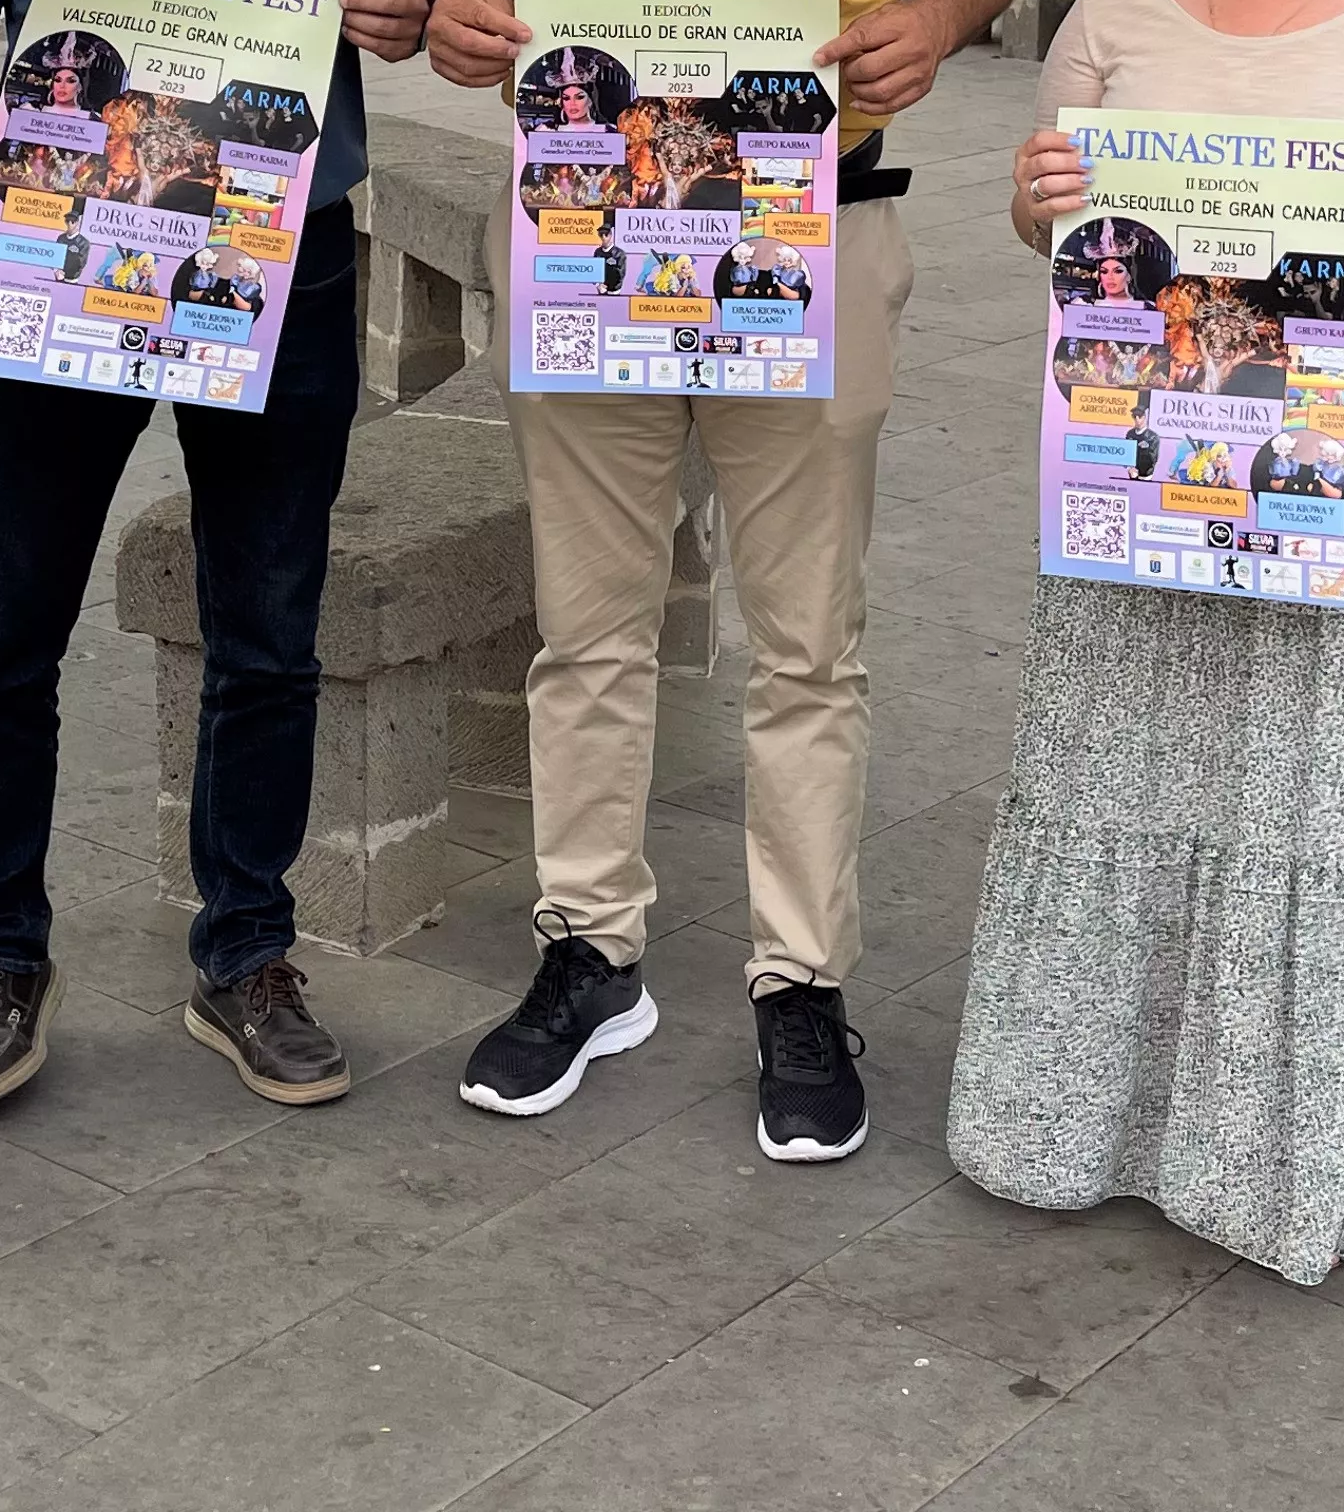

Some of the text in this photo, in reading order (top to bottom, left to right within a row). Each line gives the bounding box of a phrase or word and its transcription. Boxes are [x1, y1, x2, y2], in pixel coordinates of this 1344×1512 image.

[151, 0, 218, 22] II EDICIÓN
[642, 3, 711, 18] II EDICIÓN
[60, 5, 302, 62] VALSEQUILLO DE GRAN CANARIA
[551, 21, 803, 41] VALSEQUILLO DE GRAN CANARIA
[145, 57, 206, 82] 22 JULIO
[650, 62, 710, 77] 22 JULIO
[158, 79, 185, 94] 2023
[667, 82, 693, 93] 2023
[732, 75, 818, 95] KARMA
[223, 83, 307, 116] KARMA
[30, 118, 54, 129] DRAG
[549, 139, 573, 147] DRAG
[748, 140, 810, 149] GRUPO KARMA
[1075, 124, 1276, 170] TAJINASTE
[228, 149, 288, 167] GRUPO KARMA
[1185, 175, 1259, 194] II EDICIÓN
[14, 194, 63, 211] COMPARSA
[1090, 190, 1194, 216] VALSEQUILLO
[1202, 200, 1221, 215] DE
[1229, 200, 1274, 219] GRAN
[95, 206, 144, 229] DRAG
[547, 216, 594, 226] COMPARSA
[628, 215, 674, 232] DRAG
[89, 223, 198, 250] GANADOR LAS PALMAS
[623, 234, 732, 245] GANADOR LAS PALMAS
[5, 242, 54, 258] STRUENDO
[1192, 239, 1256, 258] 22 JULIO
[546, 264, 593, 272] STRUENDO
[1210, 260, 1237, 273] 2023
[92, 296, 117, 307] DRAG
[117, 300, 129, 309] LA
[639, 304, 662, 312] DRAG
[664, 304, 675, 312] LA
[731, 306, 755, 314] DRAG
[183, 310, 207, 320] DRAG
[1085, 313, 1110, 323] DRAG
[1295, 326, 1326, 336] GRUPO
[1079, 393, 1128, 406] COMPARSA
[1162, 398, 1212, 417] DRAG
[1157, 417, 1273, 436] GANADOR LAS PALMAS
[1076, 443, 1125, 455] STRUENDO
[1170, 492, 1195, 502] DRAG
[1197, 494, 1208, 503] LA
[1268, 501, 1294, 511] DRAG
